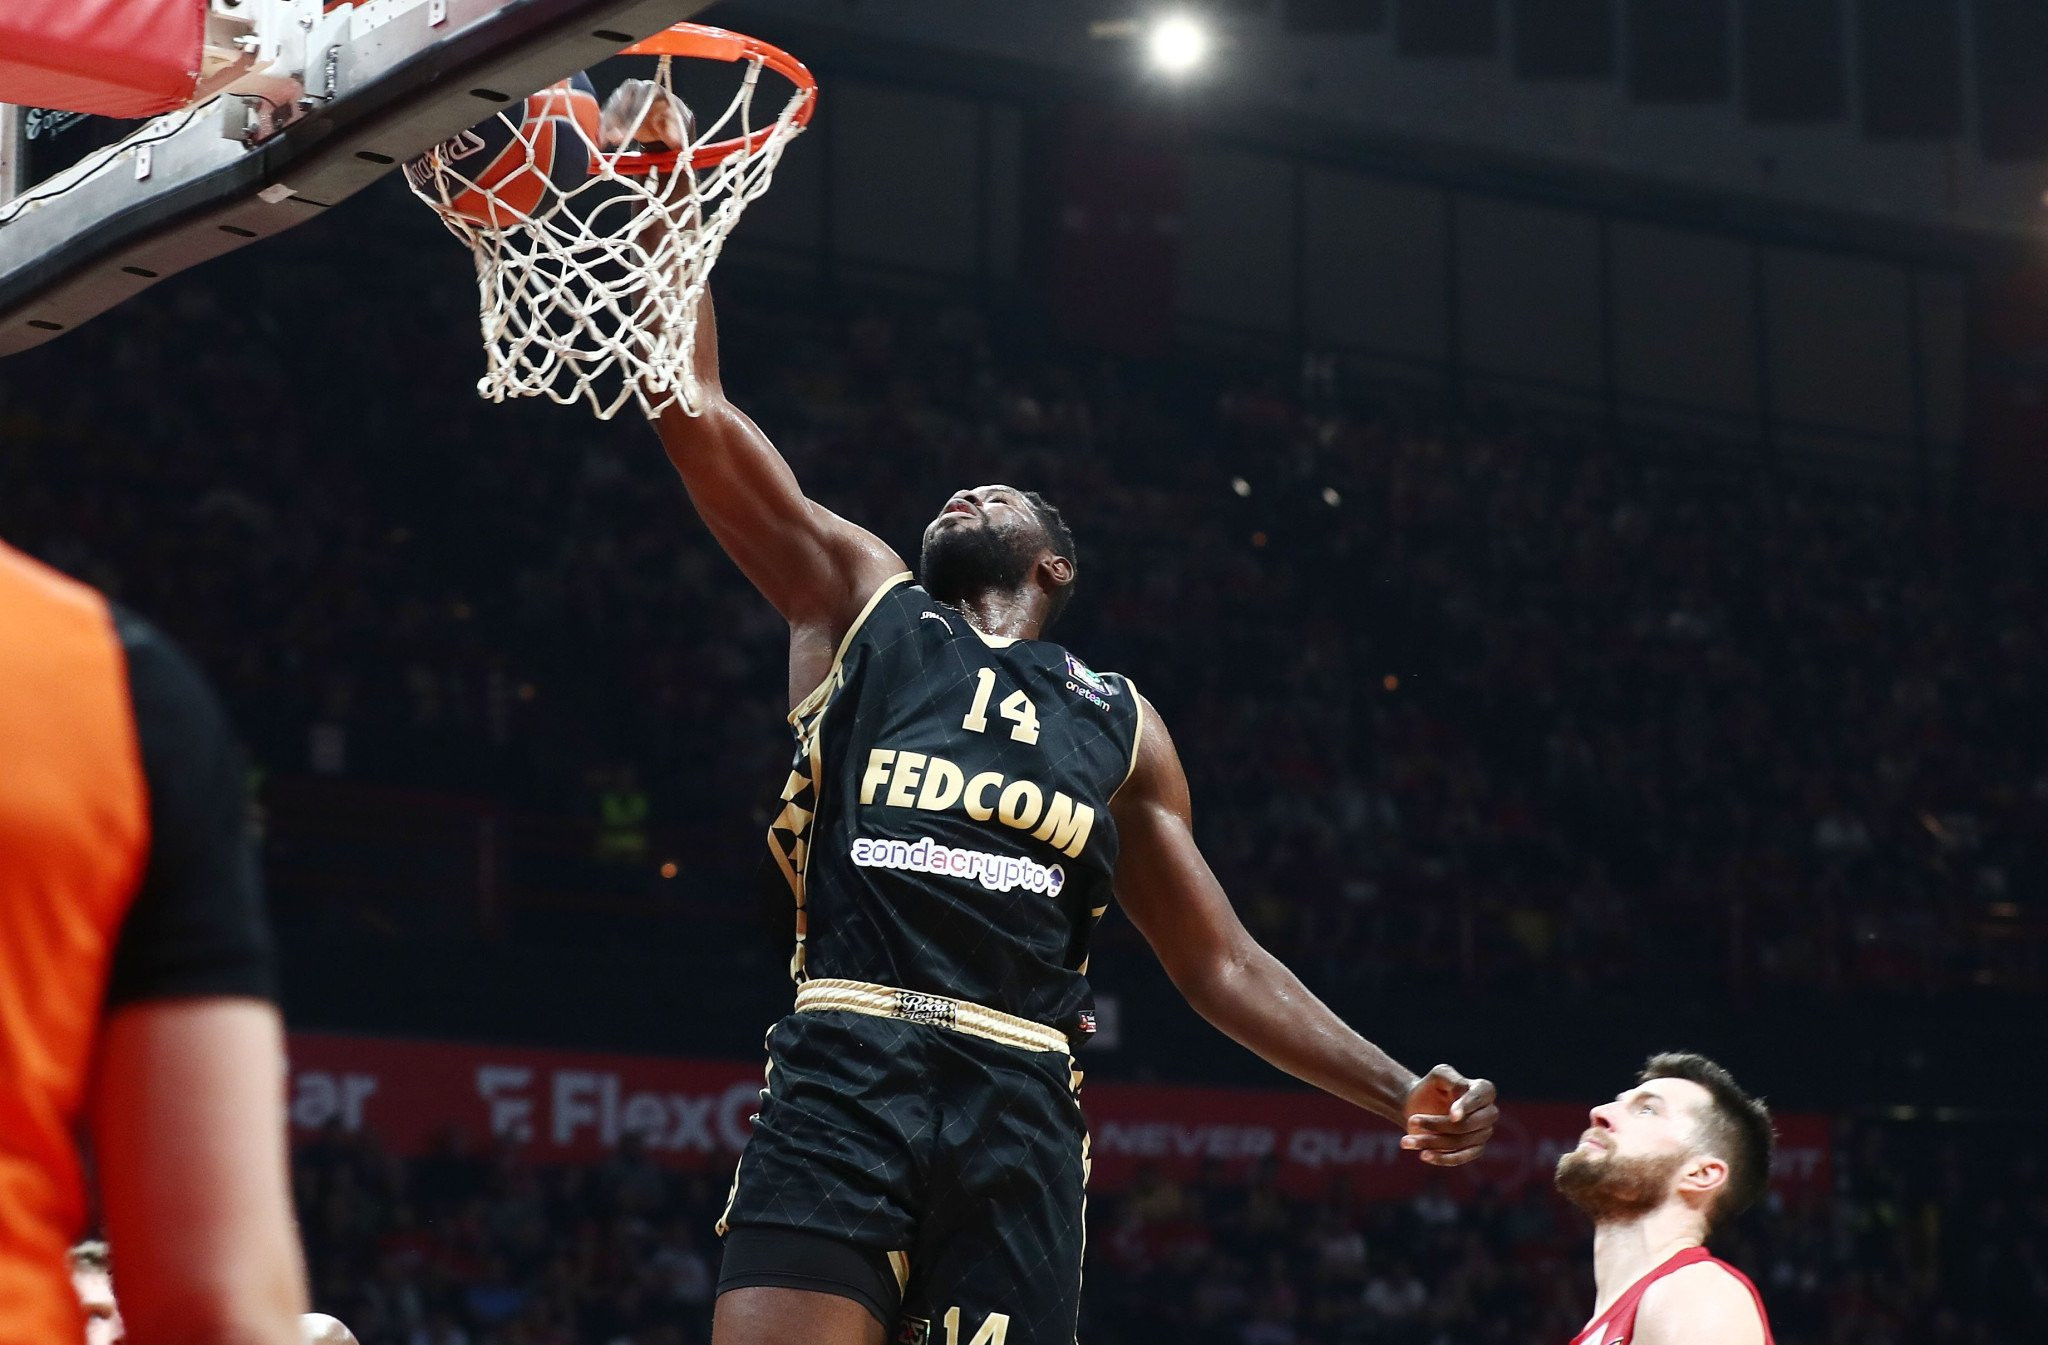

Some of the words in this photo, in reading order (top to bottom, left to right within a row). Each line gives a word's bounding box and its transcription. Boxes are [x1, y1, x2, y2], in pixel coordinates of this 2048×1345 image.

[962, 667, 1041, 746] 14
[1065, 681, 1110, 712] oneteam
[859, 748, 1095, 859] FEDCOM
[855, 841, 1047, 888] zondacrypto
[902, 995, 949, 1012] Roca
[905, 1009, 944, 1020] Team
[1097, 1122, 1276, 1158] NEVER
